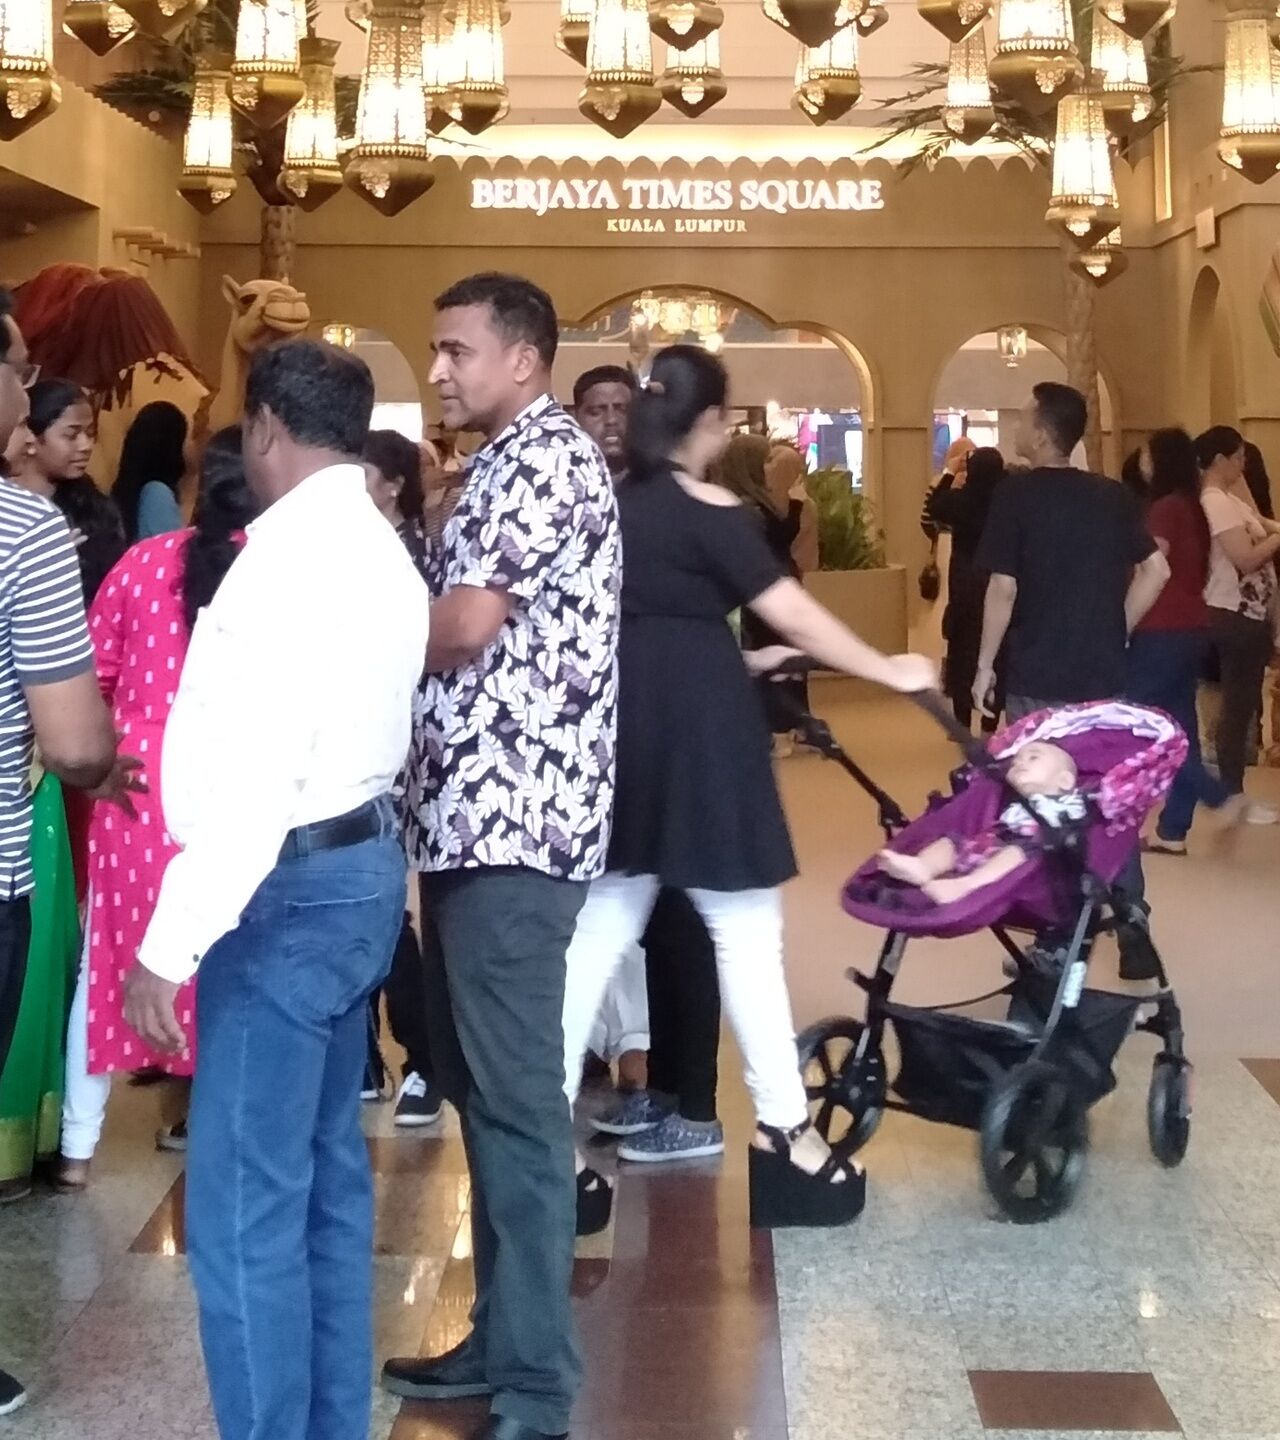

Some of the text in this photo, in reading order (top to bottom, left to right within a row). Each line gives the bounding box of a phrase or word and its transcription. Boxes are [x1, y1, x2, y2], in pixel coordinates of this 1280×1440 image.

[470, 177, 885, 216] BERJAYA TIMES SQUARE
[606, 218, 748, 234] KUALA LUMPUR
